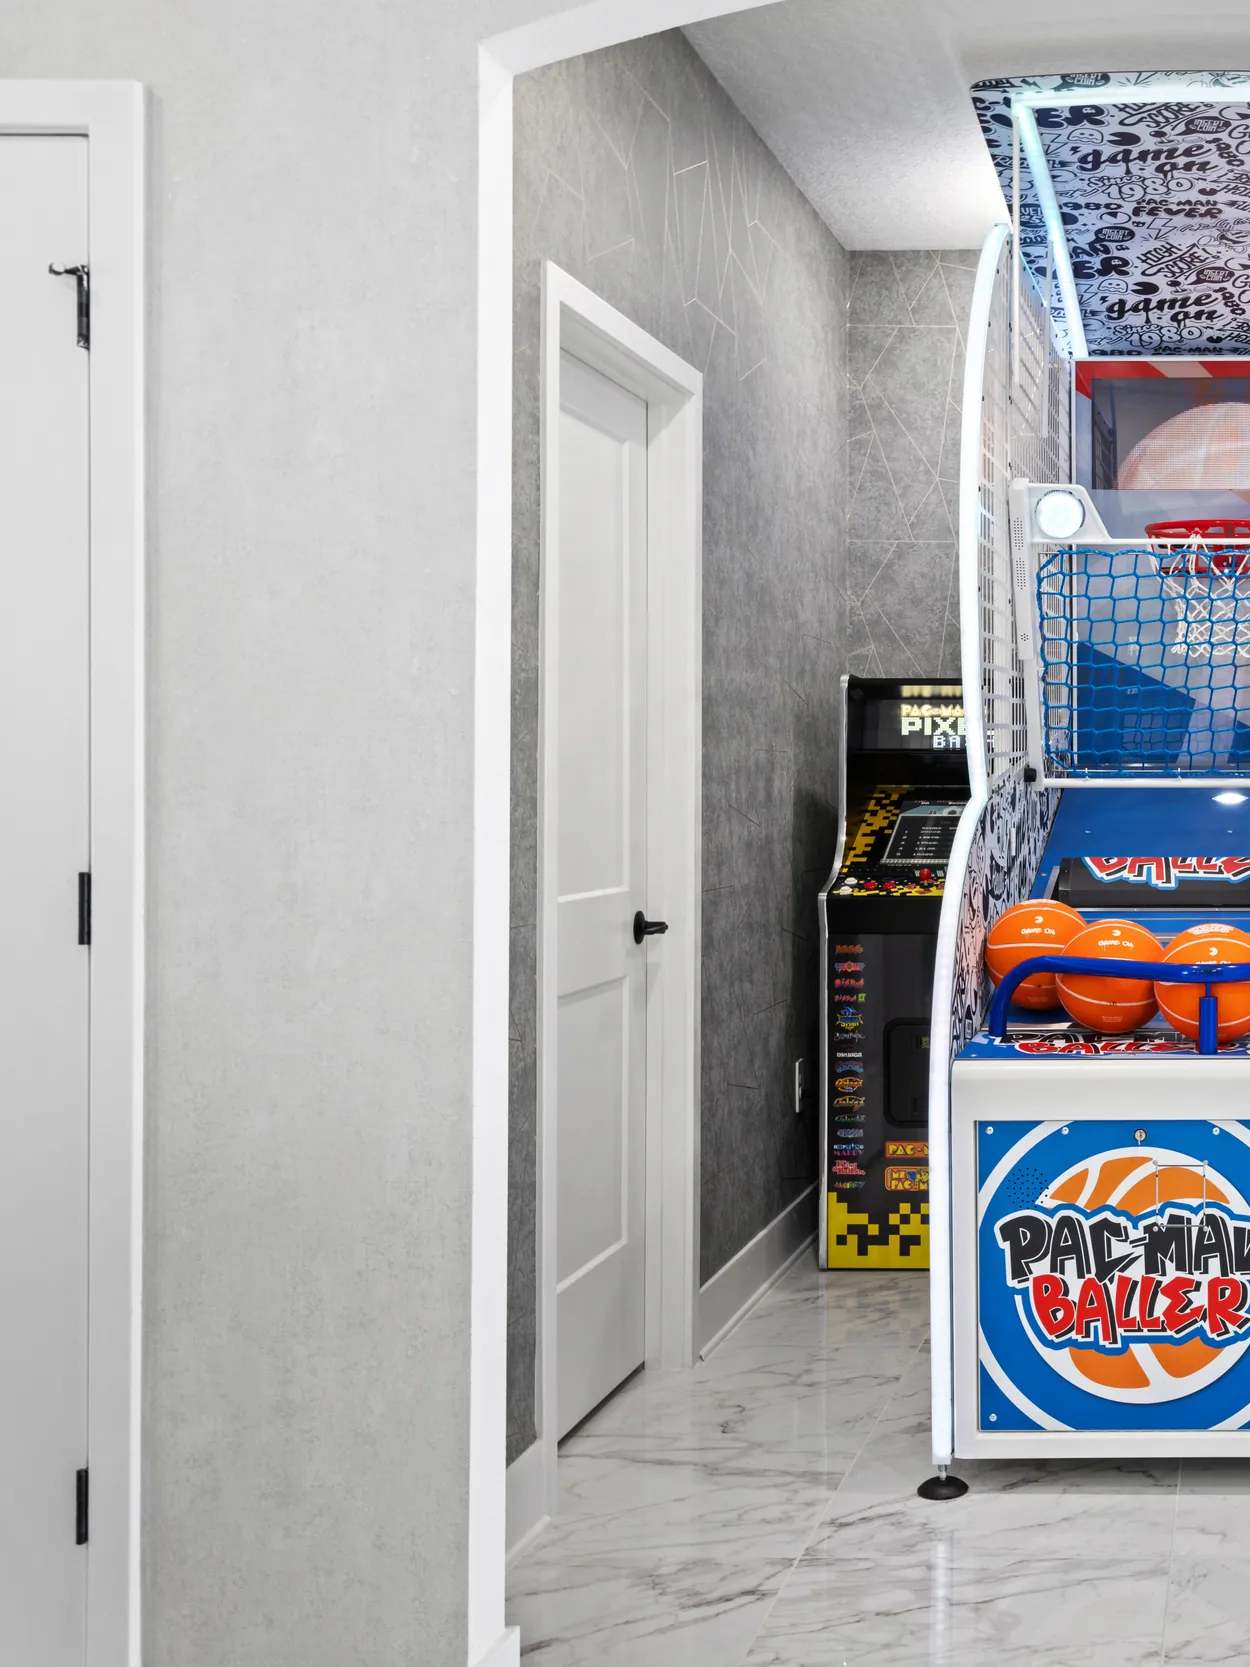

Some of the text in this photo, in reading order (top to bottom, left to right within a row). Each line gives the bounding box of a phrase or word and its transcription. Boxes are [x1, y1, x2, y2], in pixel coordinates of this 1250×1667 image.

[1076, 144, 1212, 172] game
[1155, 161, 1220, 173] on
[1087, 175, 1145, 188] Since
[1101, 177, 1193, 202] 1980
[1132, 206, 1222, 218] FEVER
[1136, 242, 1182, 267] HIGH
[1141, 247, 1221, 278] SCORE!
[1106, 293, 1219, 321] game
[1170, 310, 1224, 322] on
[1112, 323, 1163, 336] Since
[1125, 325, 1203, 350] 1980
[901, 703, 964, 718] PAC-MA
[1020, 927, 1043, 936] GAME
[1098, 939, 1121, 948] GAME
